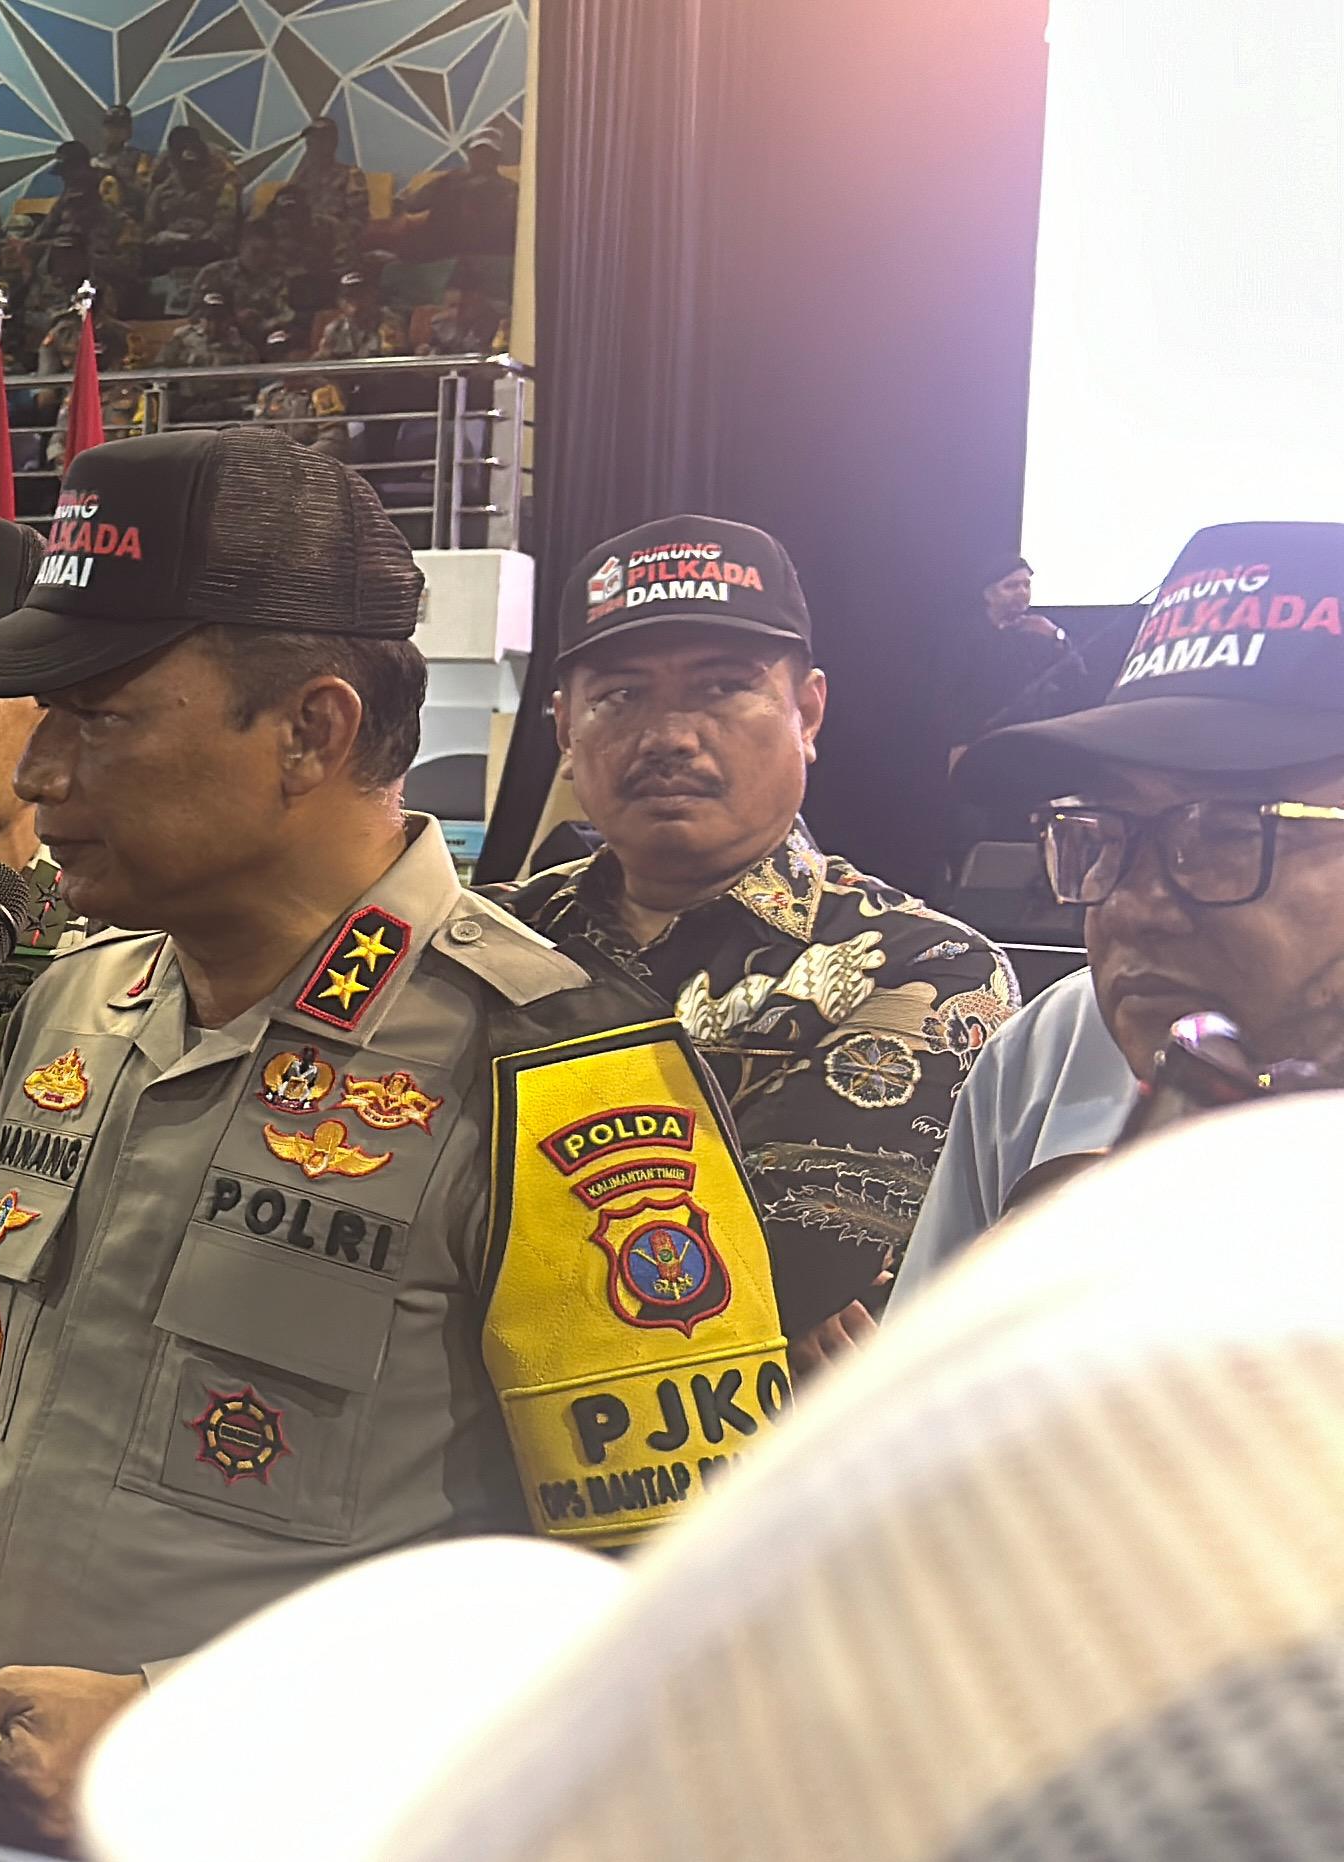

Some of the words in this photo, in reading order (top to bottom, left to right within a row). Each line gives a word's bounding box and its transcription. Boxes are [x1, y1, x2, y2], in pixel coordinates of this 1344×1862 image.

[33, 555, 94, 588] AMAI
[627, 542, 721, 568] DUKUNG
[627, 559, 764, 592] PILKADA
[626, 580, 729, 608] DAMAI
[1137, 593, 1342, 653] PILKADA
[1118, 632, 1266, 688] DAMAI
[563, 1114, 683, 1159] POLDA
[587, 1167, 654, 1197] KALIMANTAN
[654, 1167, 686, 1180] TIMUR
[207, 1176, 394, 1271] POLRI
